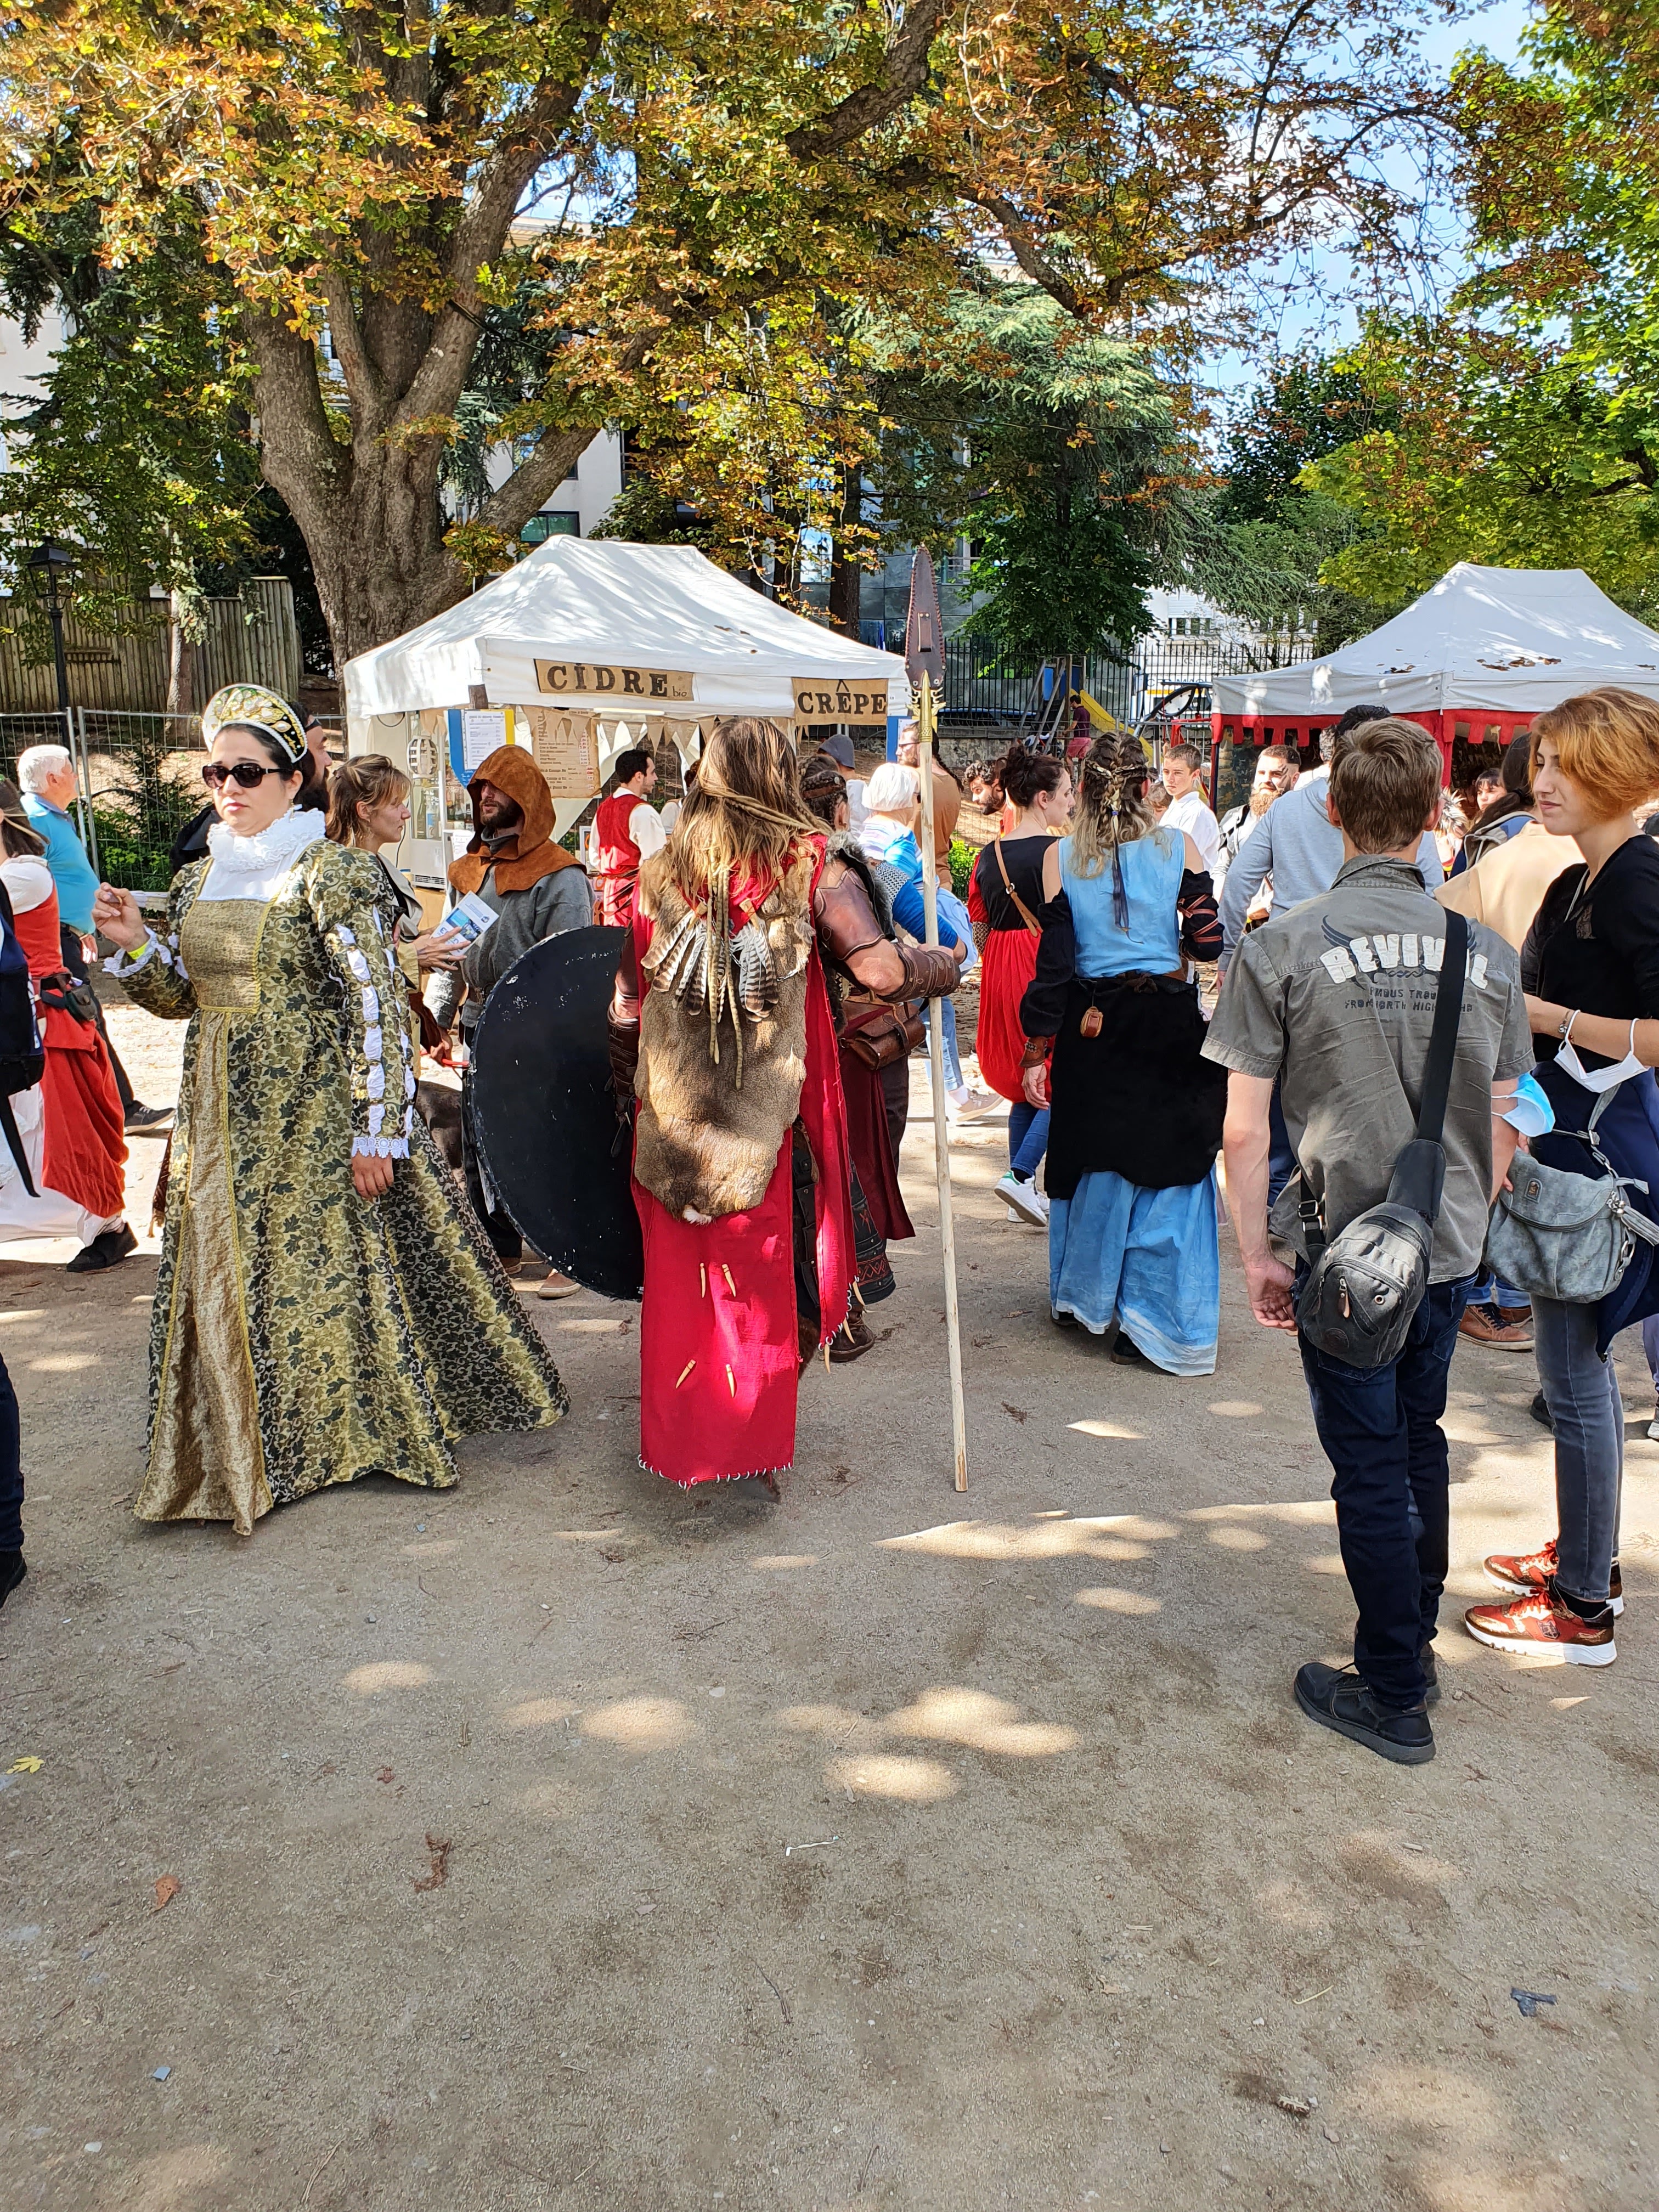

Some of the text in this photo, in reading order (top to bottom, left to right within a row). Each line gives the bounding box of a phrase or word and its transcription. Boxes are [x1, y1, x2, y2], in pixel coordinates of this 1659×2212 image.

[673, 686, 687, 697] bio
[797, 679, 887, 715] CRÊPE
[1319, 933, 1488, 990] REVIVL
